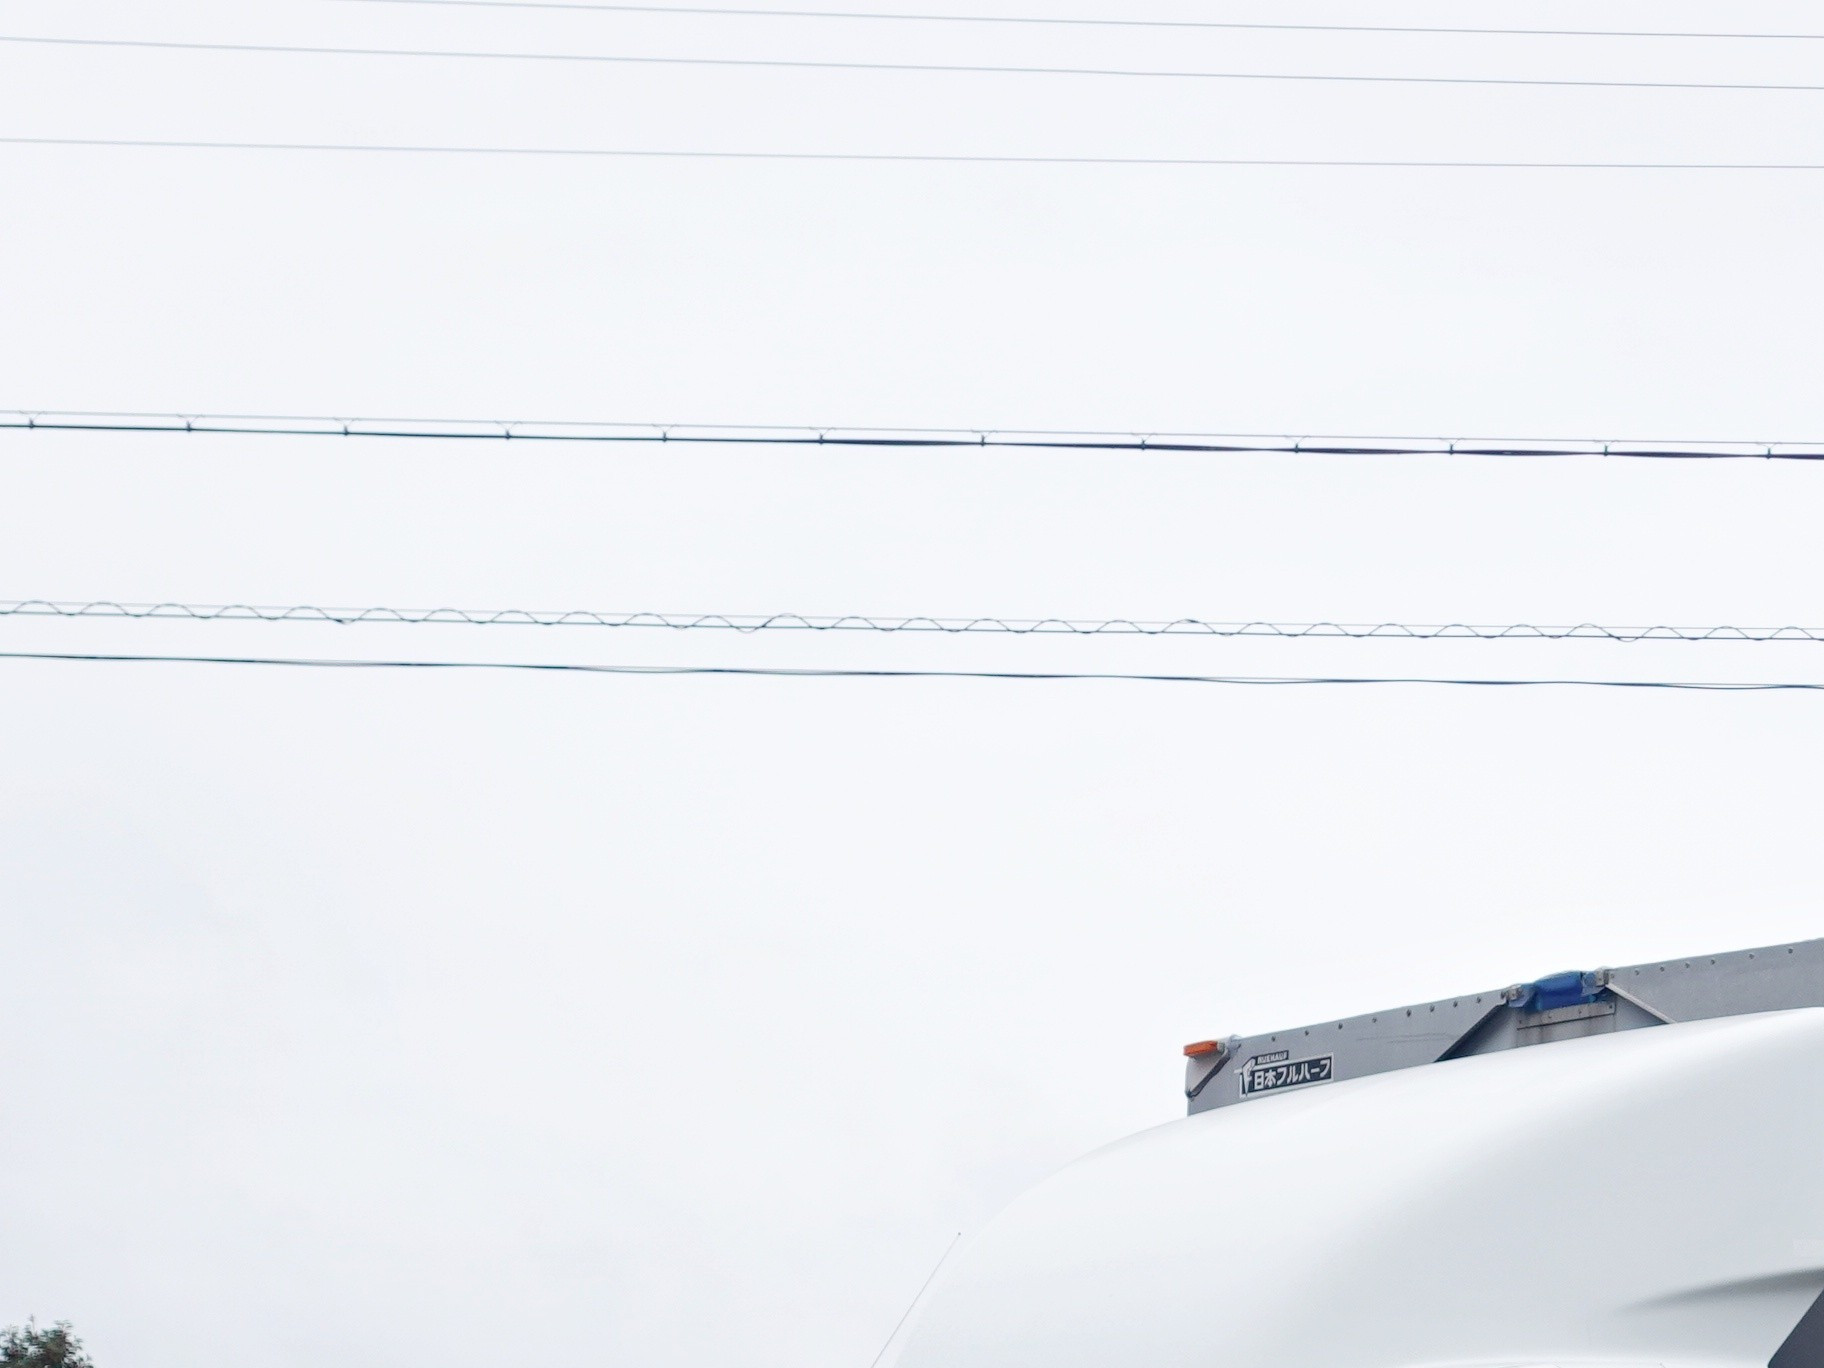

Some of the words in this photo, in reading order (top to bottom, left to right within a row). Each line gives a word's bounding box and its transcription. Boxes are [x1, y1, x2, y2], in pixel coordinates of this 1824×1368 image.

[1254, 1060, 1331, 1090] 日本フルハーフ
